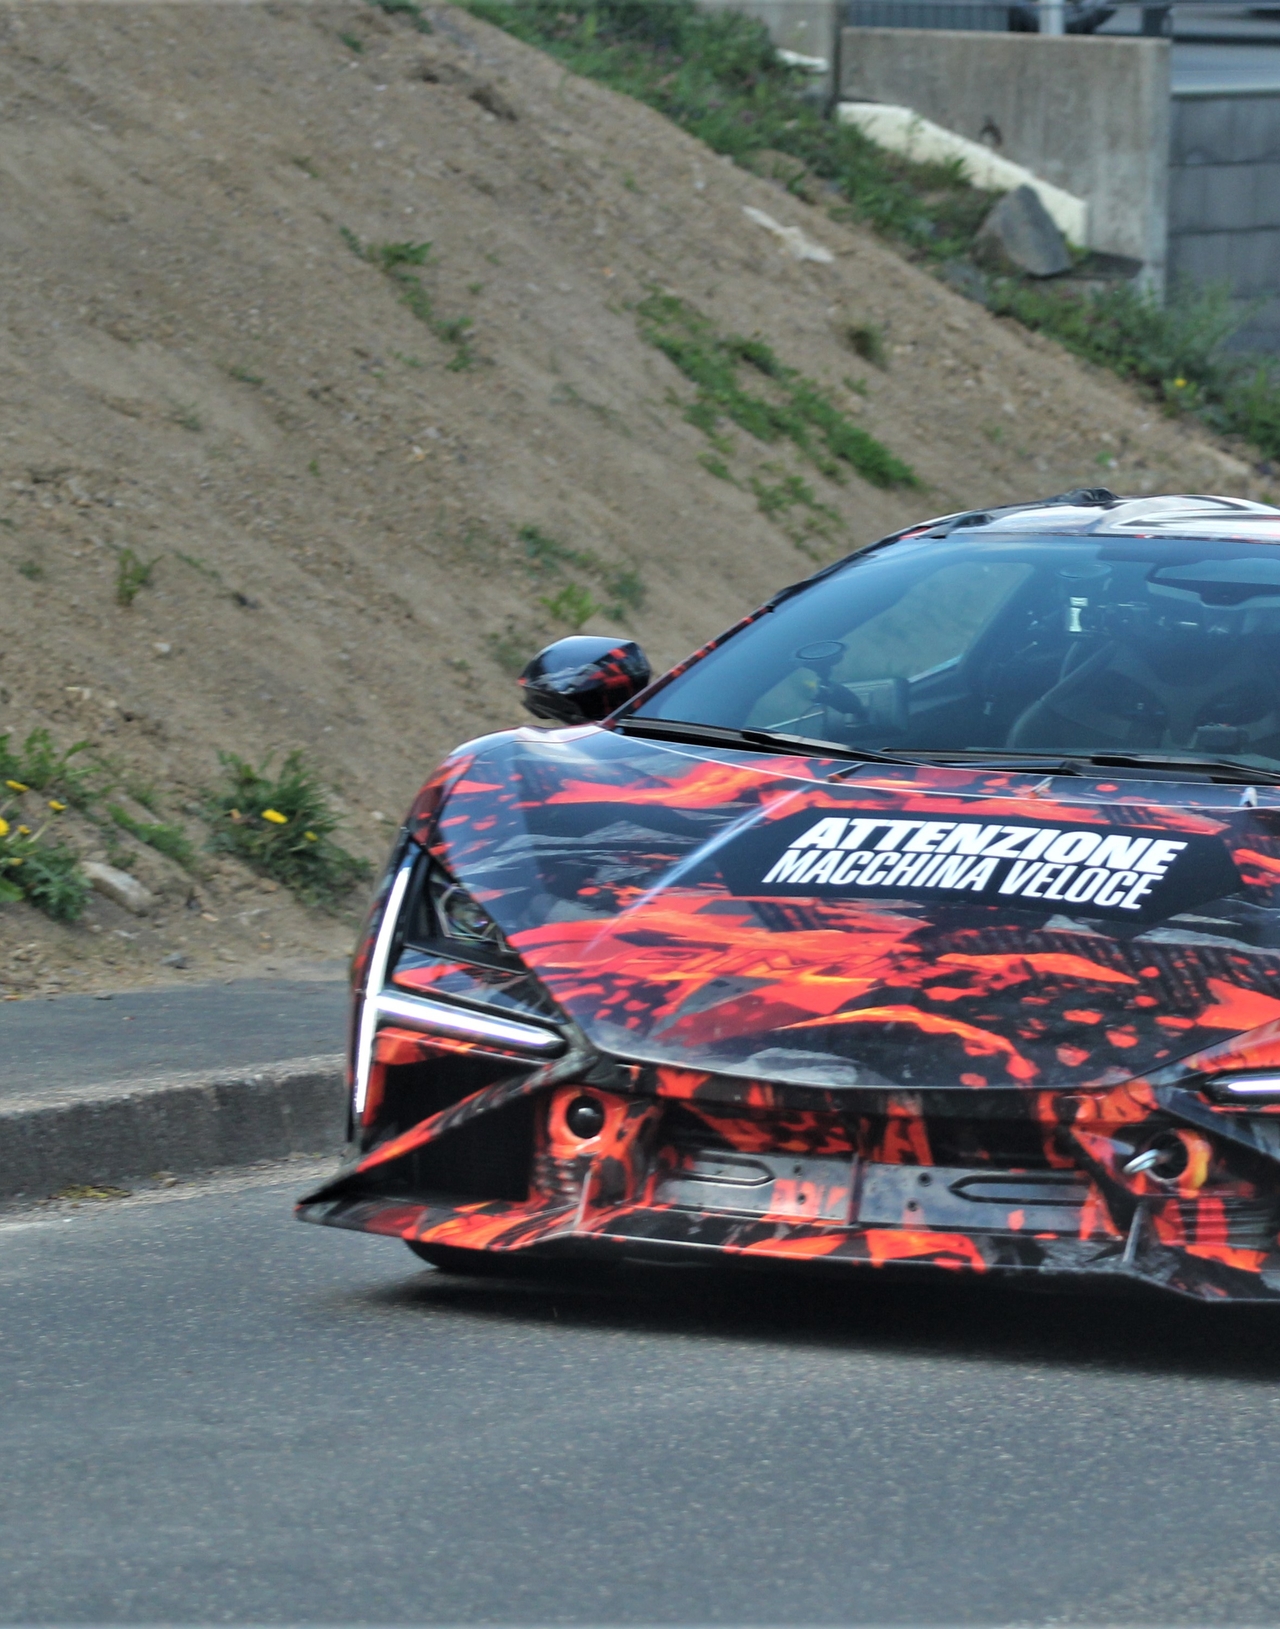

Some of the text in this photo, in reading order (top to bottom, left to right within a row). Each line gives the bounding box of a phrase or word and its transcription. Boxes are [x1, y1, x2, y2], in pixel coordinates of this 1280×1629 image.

[788, 816, 1188, 874] ATTENZIONE
[761, 849, 1164, 909] MACCHINA VELOCE
